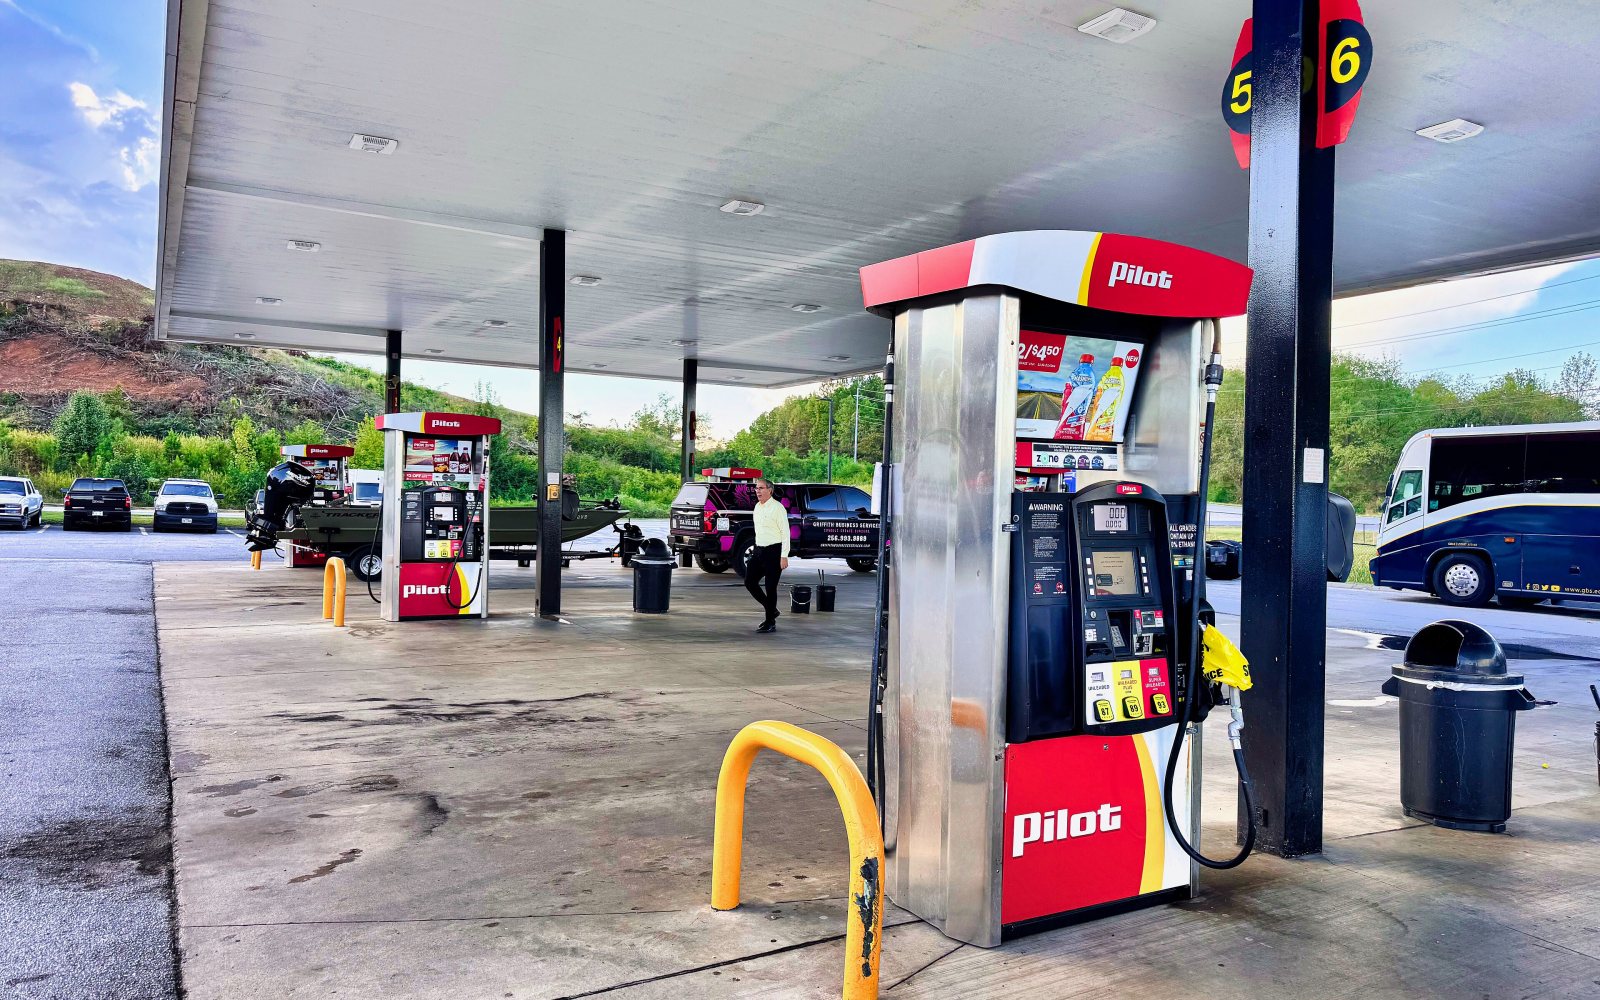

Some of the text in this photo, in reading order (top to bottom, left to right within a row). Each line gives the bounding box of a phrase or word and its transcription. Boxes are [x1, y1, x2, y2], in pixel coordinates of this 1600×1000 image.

[1330, 37, 1361, 84] 6
[1230, 70, 1252, 114] 5
[1108, 261, 1174, 289] Pilot
[431, 419, 460, 428] Pilot
[1033, 503, 1064, 511] WARNING
[1169, 524, 1178, 532] ALL
[403, 584, 451, 598] Pilot
[1100, 707, 1109, 715] 87
[1129, 704, 1139, 712] 89
[1012, 803, 1122, 858] Pilot
